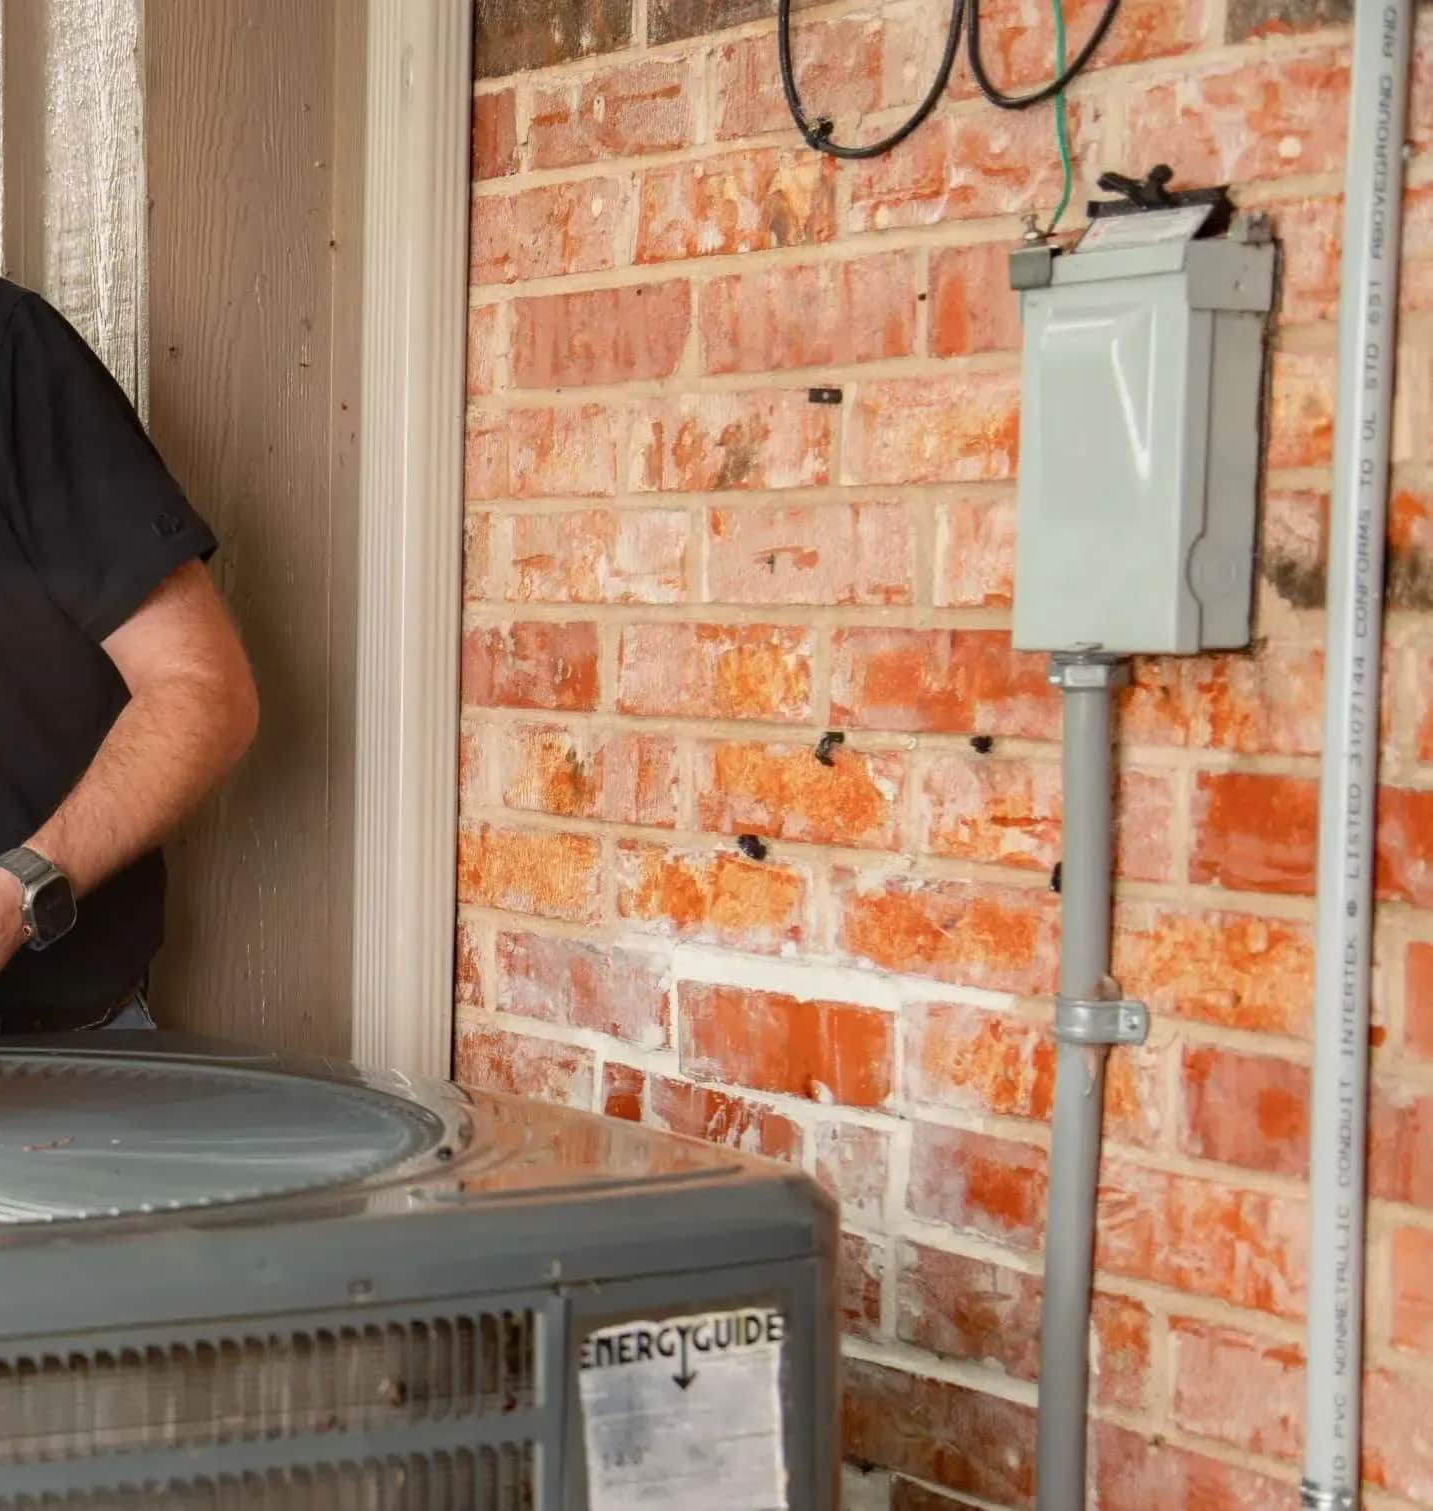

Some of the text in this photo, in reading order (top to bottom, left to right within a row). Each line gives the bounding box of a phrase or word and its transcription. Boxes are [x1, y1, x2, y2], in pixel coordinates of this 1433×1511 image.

[1381, 5, 1398, 57] AND
[1370, 73, 1393, 258] ABOVEGROUND
[1368, 279, 1382, 324] 651
[1364, 341, 1379, 389] STD
[1361, 411, 1376, 440] UL
[1359, 457, 1374, 487] TO
[1354, 508, 1371, 637] CONFORMS
[1346, 782, 1361, 878] LISTED
[1339, 934, 1357, 1056] INTERTEK
[1337, 1076, 1353, 1187] CONDUIT
[1333, 1202, 1350, 1375] NONMETALLIC
[580, 1313, 784, 1371] ENERGYGUIDE
